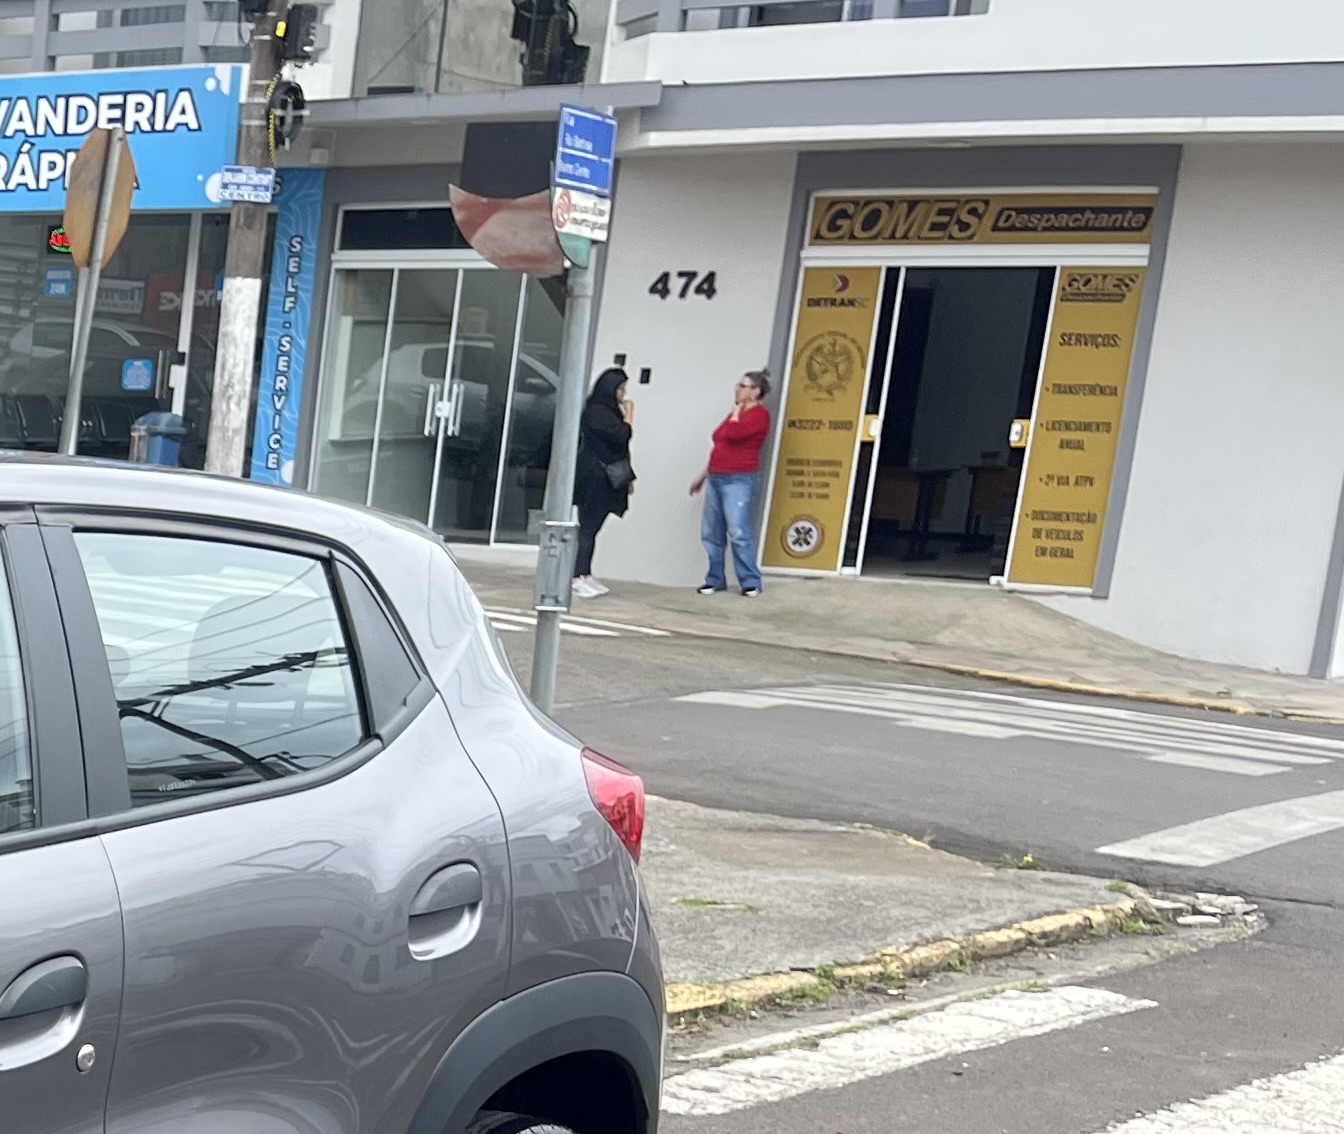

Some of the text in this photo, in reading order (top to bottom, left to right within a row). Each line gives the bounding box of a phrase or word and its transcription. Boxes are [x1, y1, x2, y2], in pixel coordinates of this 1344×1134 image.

[816, 200, 1147, 241] GOMES Despachante
[649, 270, 717, 301] 474
